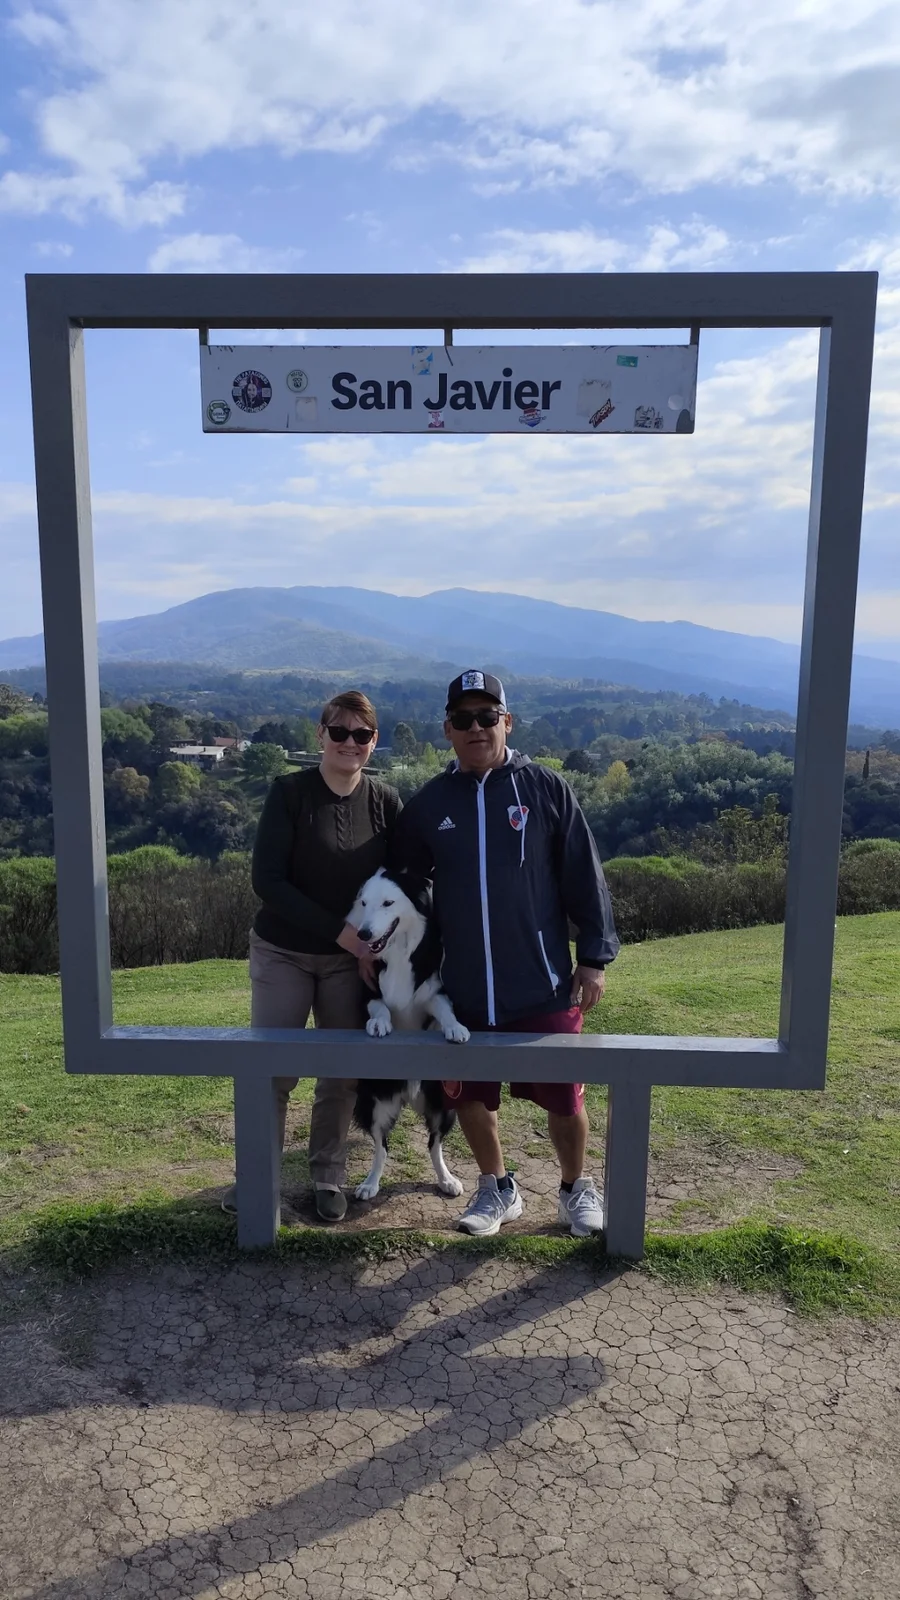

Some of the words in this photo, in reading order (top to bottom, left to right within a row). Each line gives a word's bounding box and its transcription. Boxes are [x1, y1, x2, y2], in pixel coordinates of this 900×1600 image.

[331, 372, 412, 410] San
[423, 367, 562, 411] Javier
[438, 823, 456, 831] adidas
